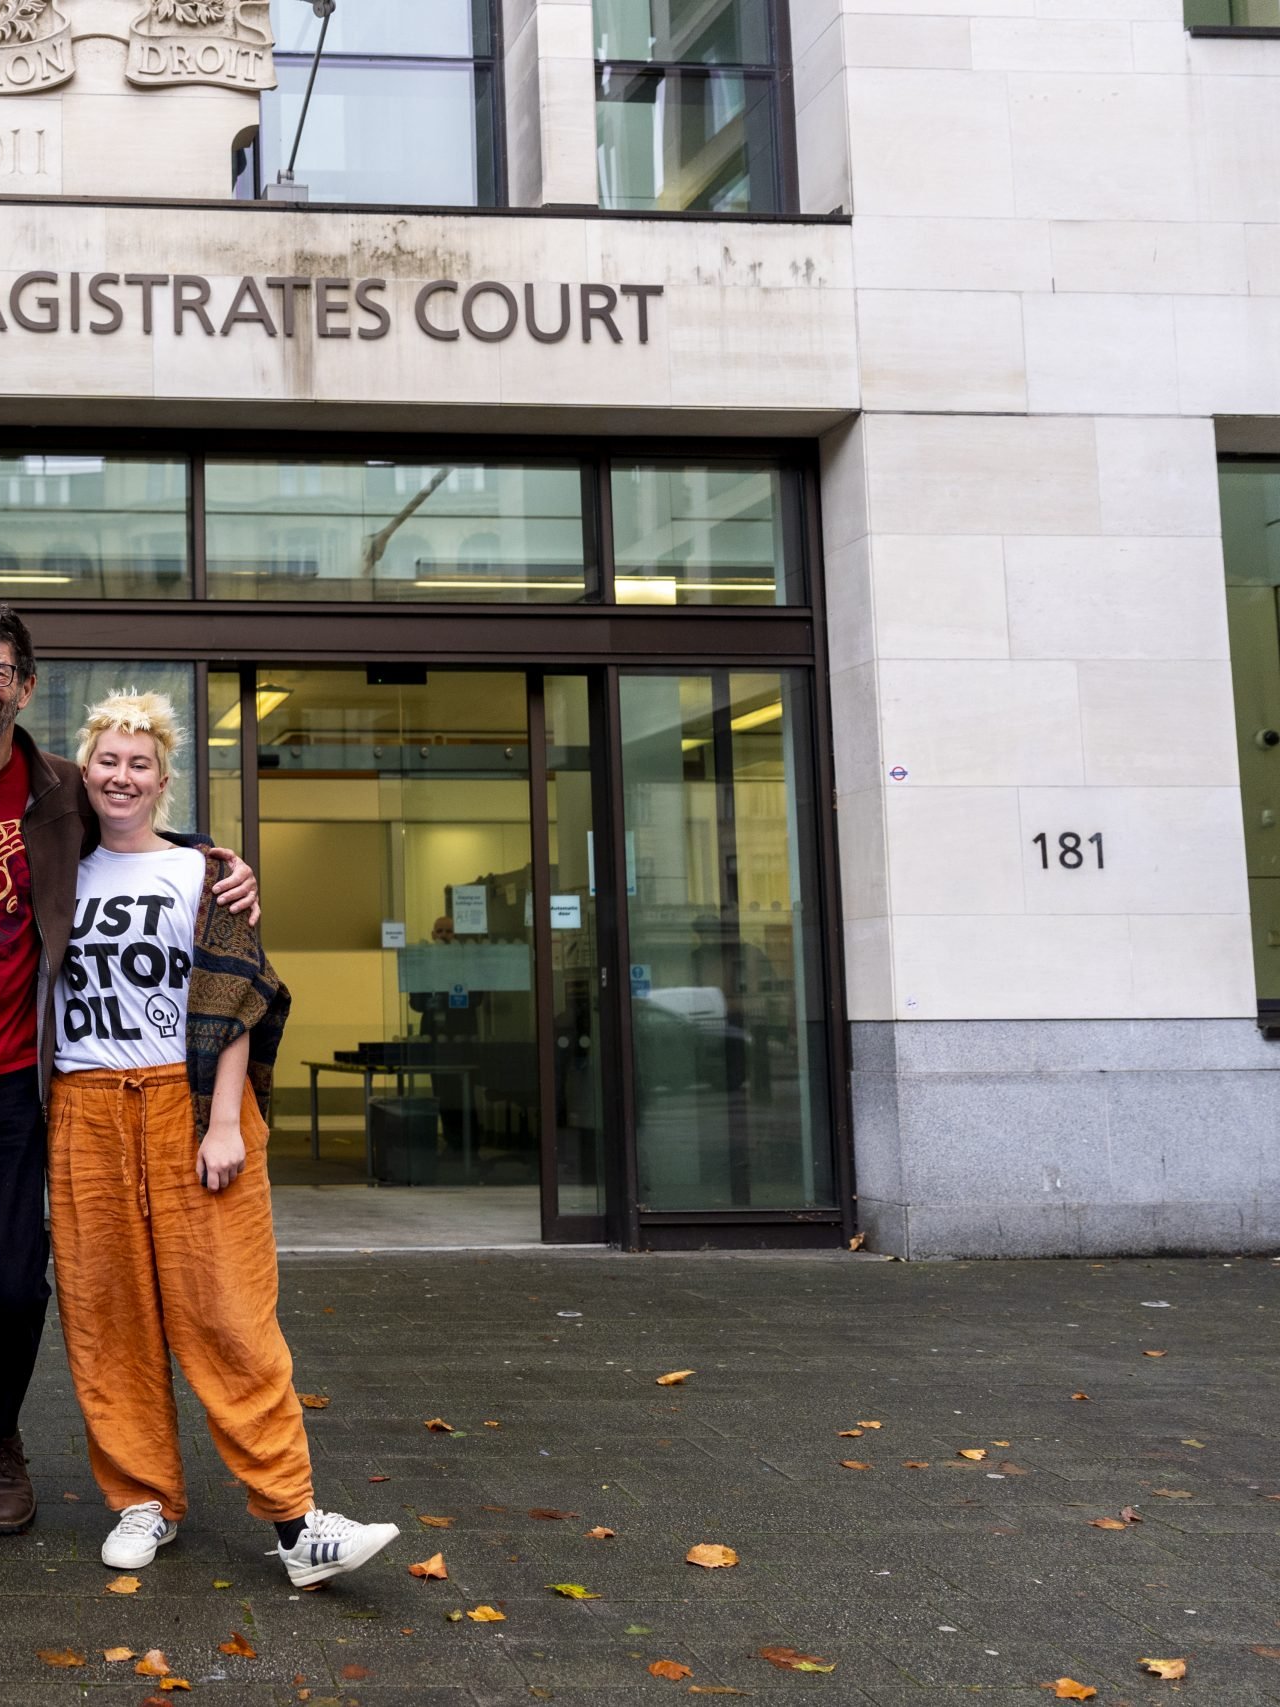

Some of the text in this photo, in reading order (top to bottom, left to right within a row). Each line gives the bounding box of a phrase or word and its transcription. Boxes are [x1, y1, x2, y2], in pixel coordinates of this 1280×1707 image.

[138, 45, 263, 82] DROIT
[414, 280, 664, 344] COURT
[1032, 832, 1104, 869] 181
[70, 895, 176, 940] UST
[63, 941, 192, 992] STOP
[63, 995, 143, 1043] OIL
